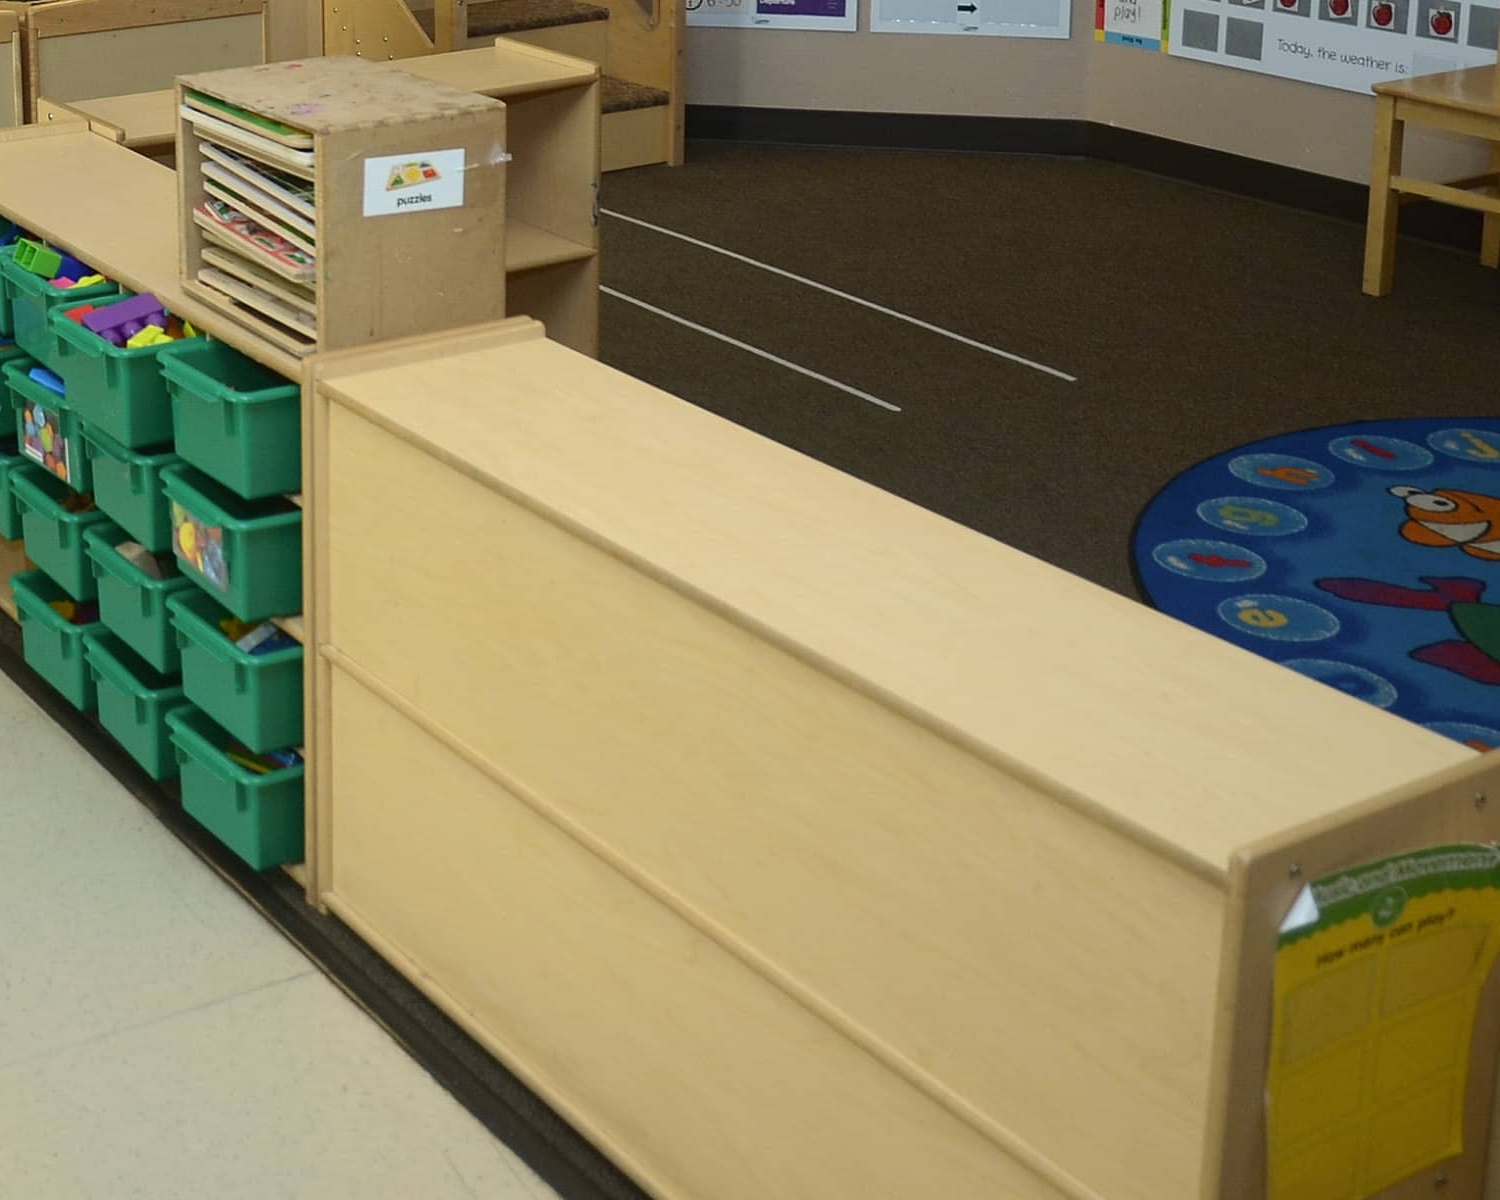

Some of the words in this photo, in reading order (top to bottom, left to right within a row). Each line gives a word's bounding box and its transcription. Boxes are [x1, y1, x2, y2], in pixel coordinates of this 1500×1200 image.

[1317, 46, 1337, 61] the
[1340, 51, 1392, 72] weather
[396, 191, 433, 209] puzzles
[1316, 949, 1344, 968] How
[1388, 922, 1413, 939] can
